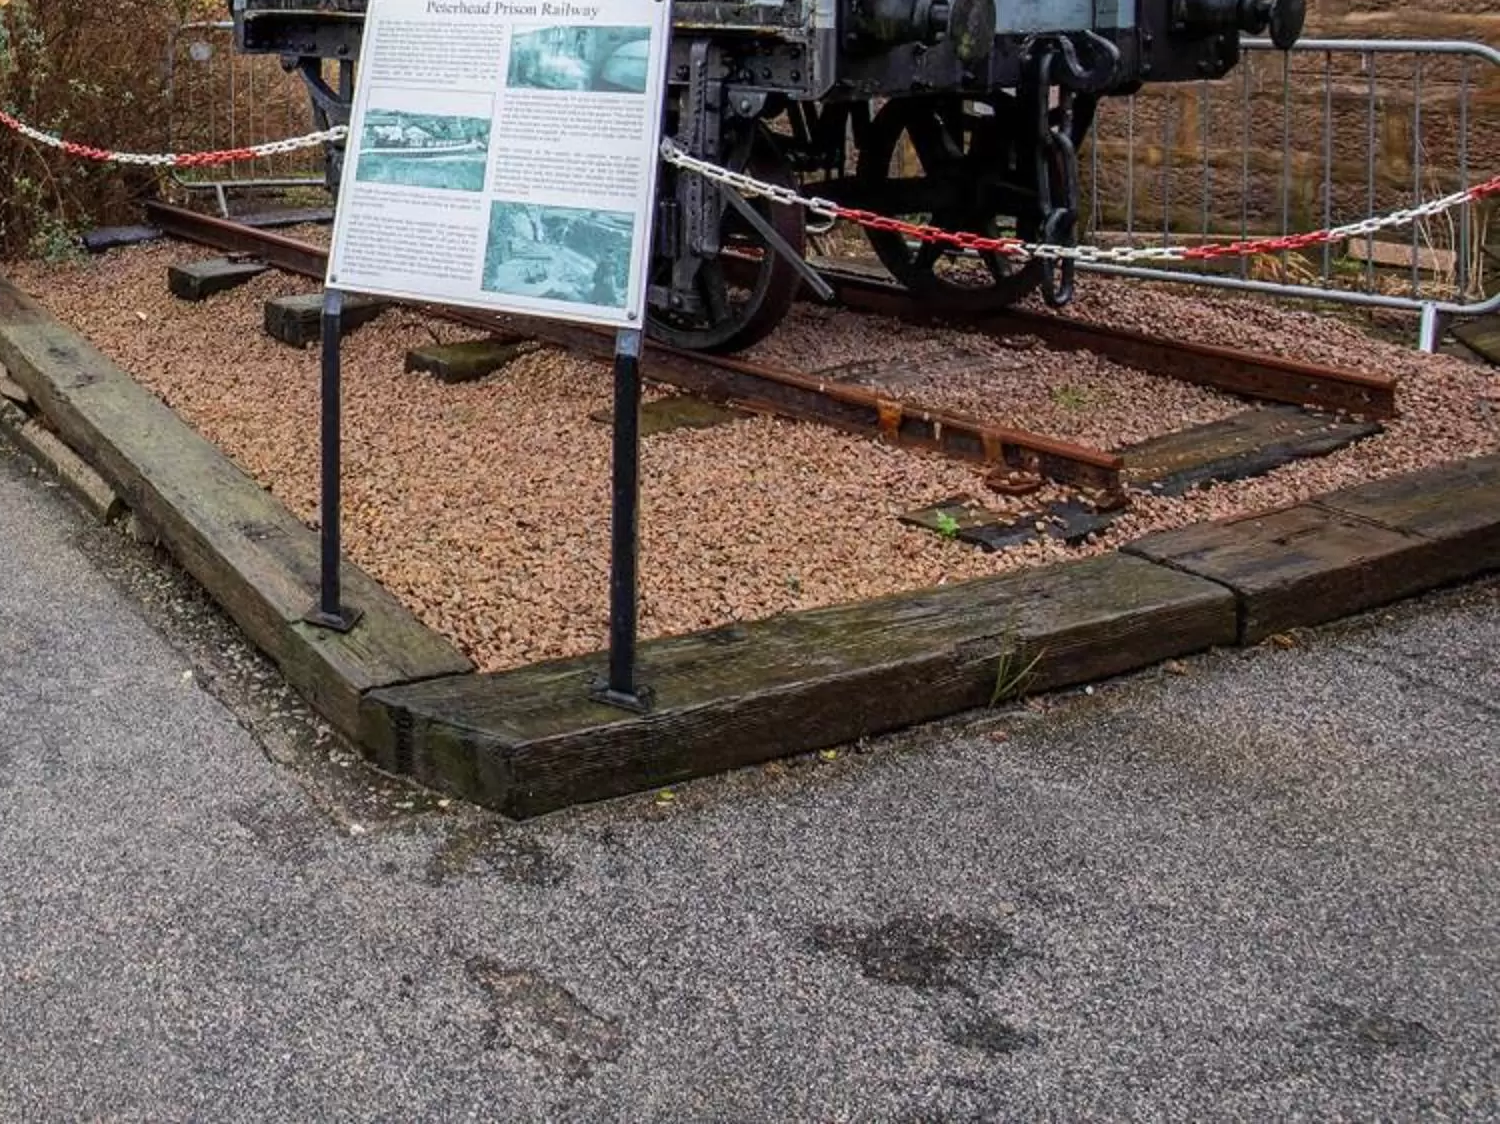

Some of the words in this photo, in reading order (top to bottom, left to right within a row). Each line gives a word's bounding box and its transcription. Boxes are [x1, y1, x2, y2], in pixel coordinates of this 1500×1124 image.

[426, 0, 491, 15] Peterhead
[494, 1, 537, 16] Prison
[541, 2, 599, 20] Railway
